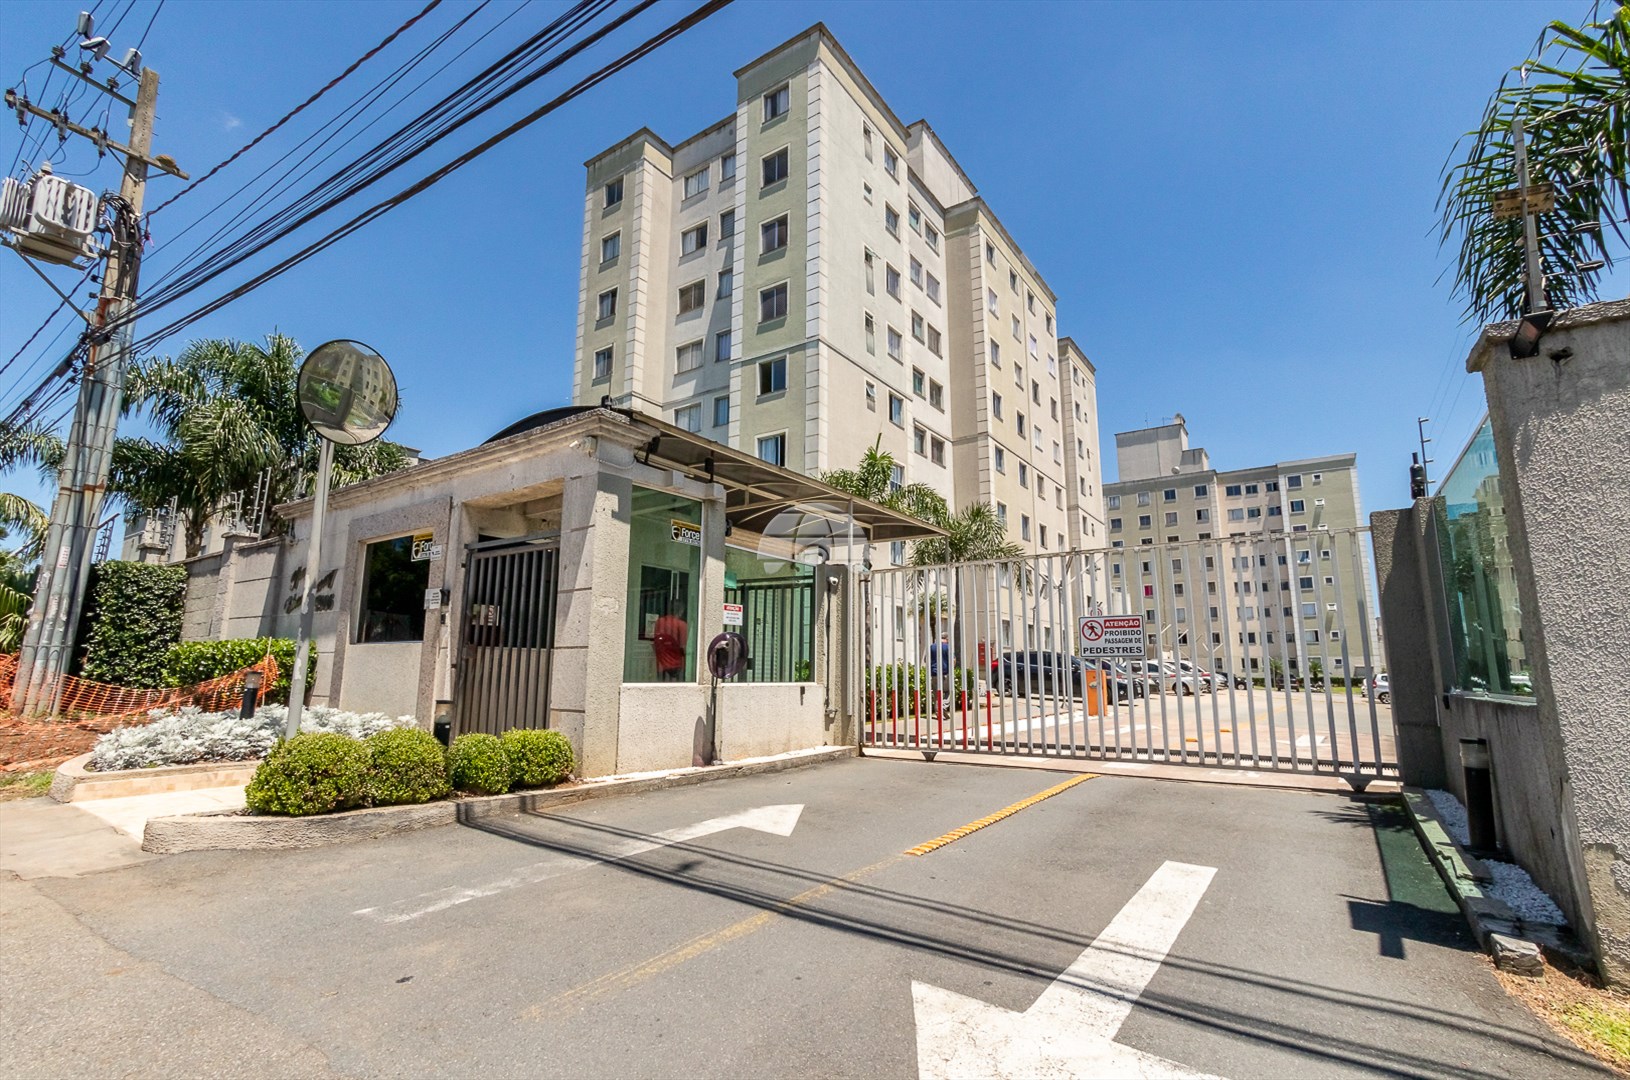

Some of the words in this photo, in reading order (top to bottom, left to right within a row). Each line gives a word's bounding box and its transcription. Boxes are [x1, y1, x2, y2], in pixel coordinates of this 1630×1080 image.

[681, 528, 700, 540] Force
[1104, 619, 1140, 627] ATENÇÃO
[1083, 646, 1142, 654] PEDESTRES
